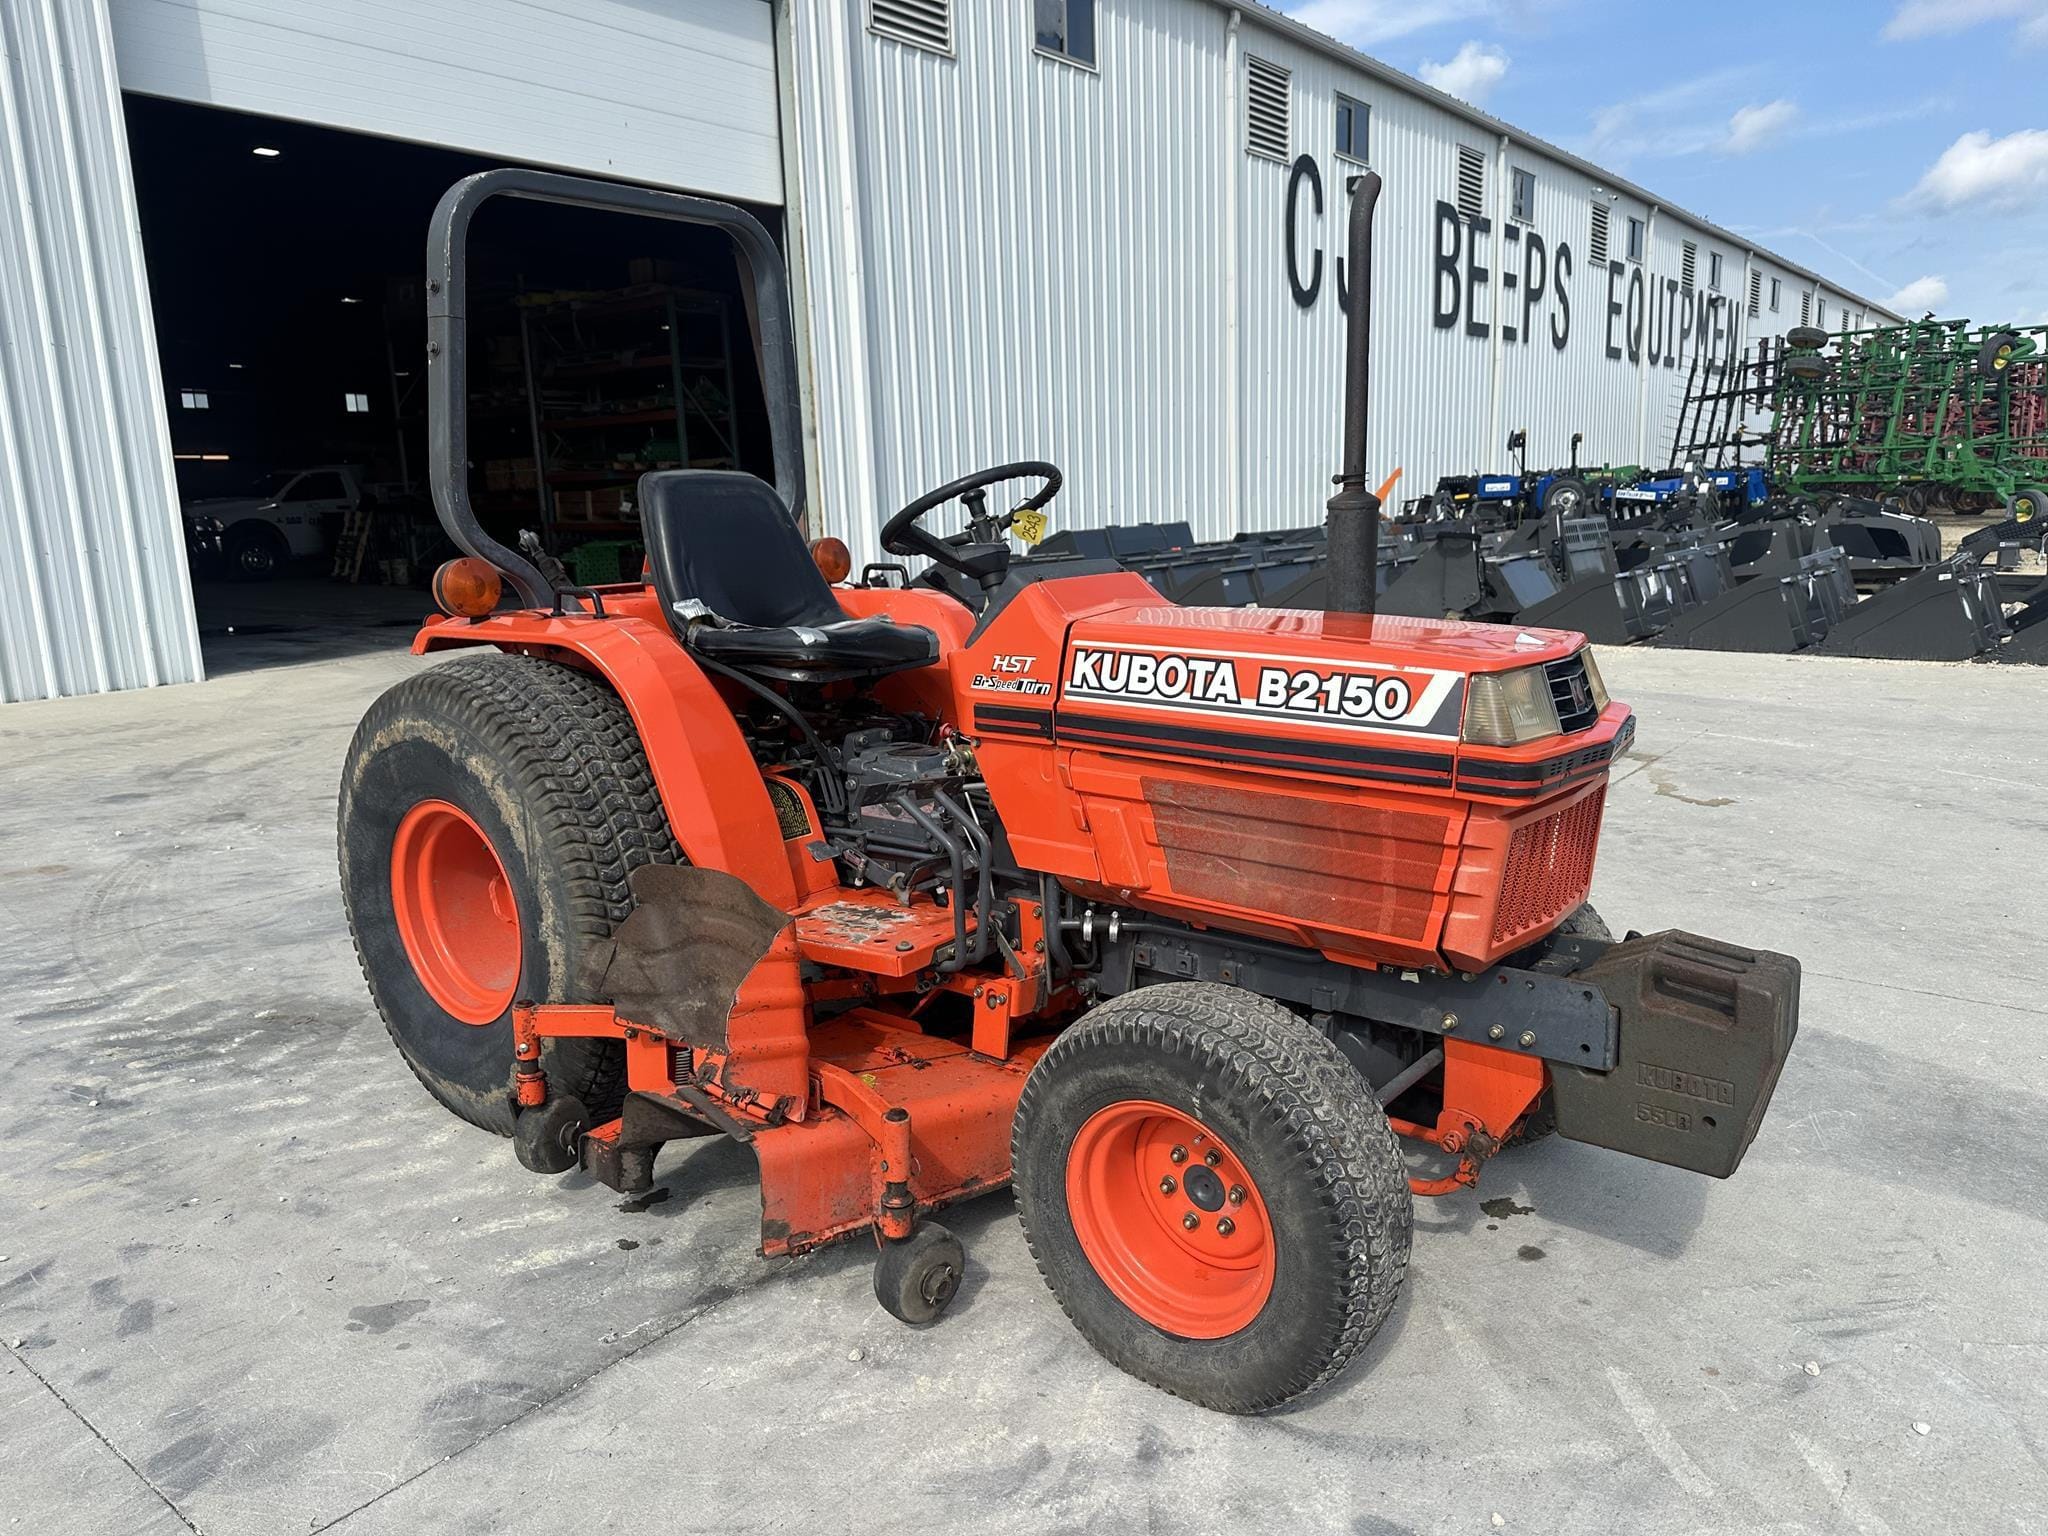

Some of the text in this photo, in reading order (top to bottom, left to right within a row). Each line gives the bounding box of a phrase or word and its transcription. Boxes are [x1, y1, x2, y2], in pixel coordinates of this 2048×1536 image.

[1434, 200, 1572, 350] BEEPS
[1606, 260, 1751, 376] EQUIPMEN
[1022, 514, 1041, 541] 2543
[991, 654, 1037, 673] HST
[1070, 647, 1411, 720] KUBOTA B2150
[1637, 1061, 1735, 1107] KUBOTA
